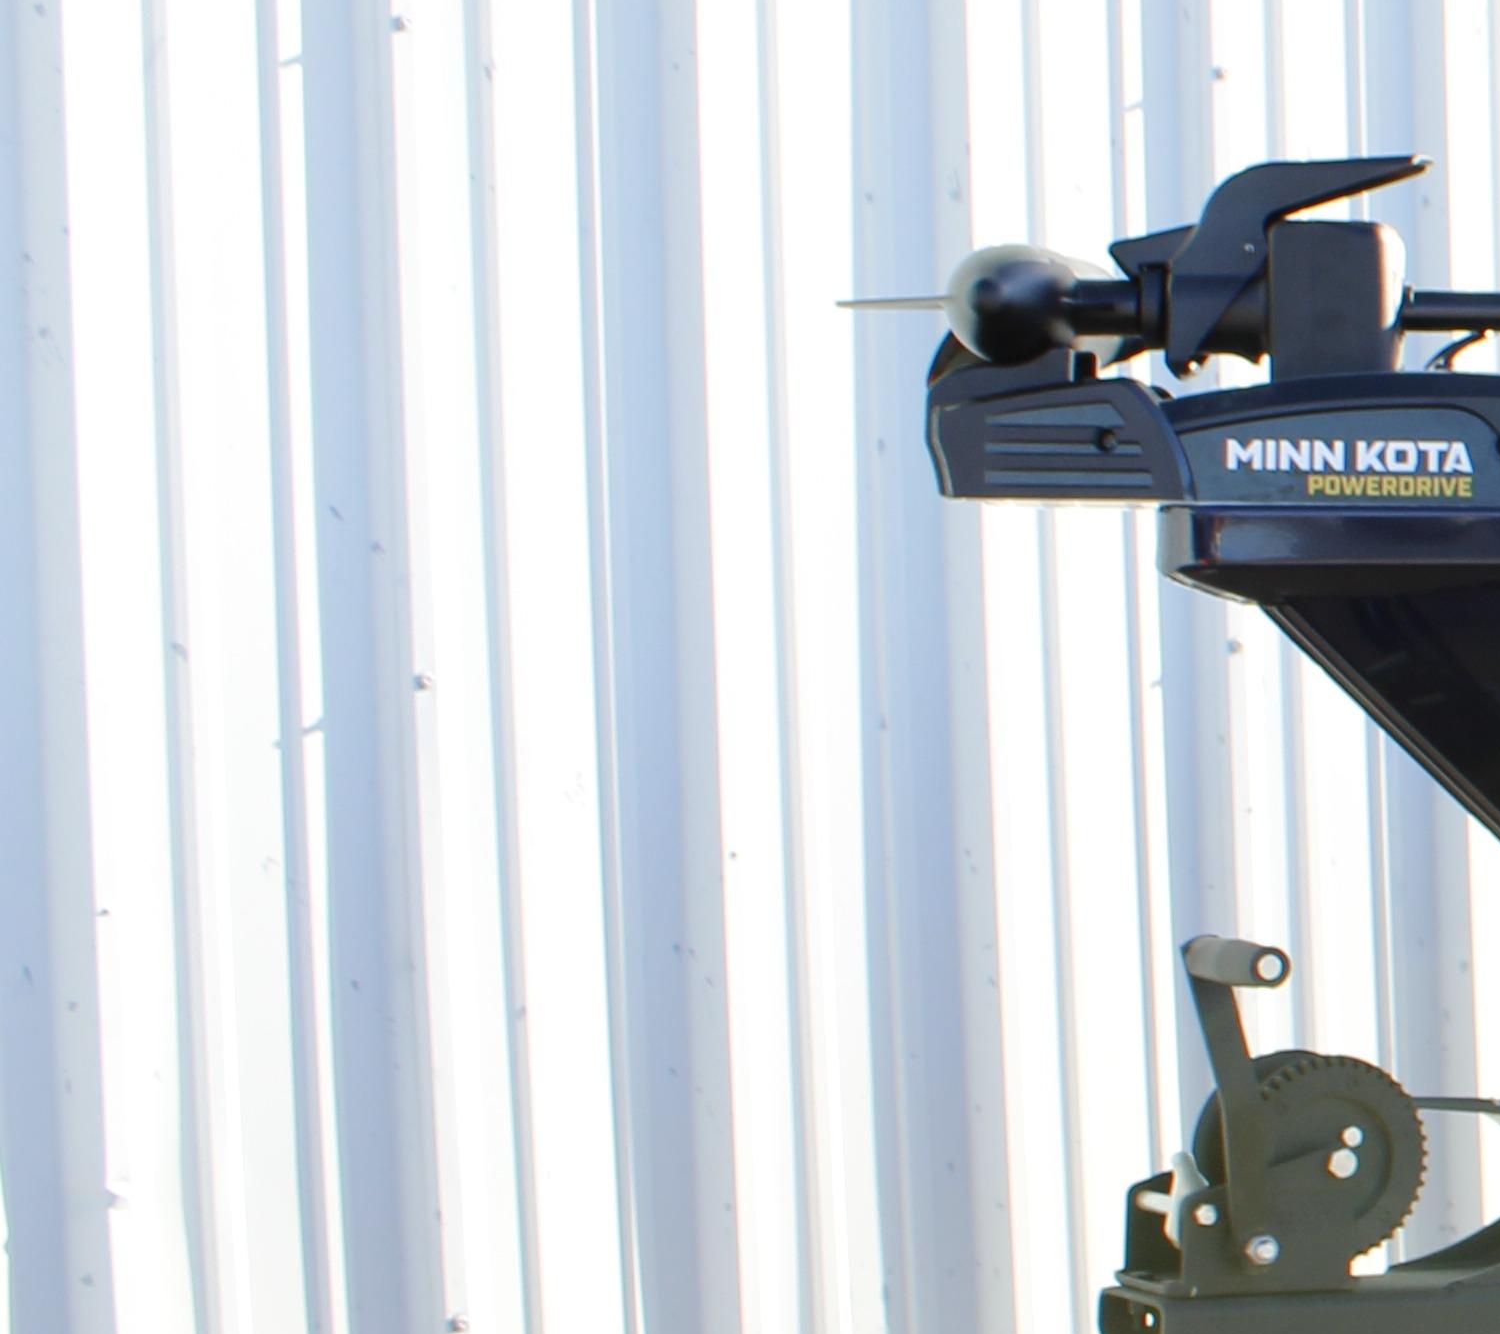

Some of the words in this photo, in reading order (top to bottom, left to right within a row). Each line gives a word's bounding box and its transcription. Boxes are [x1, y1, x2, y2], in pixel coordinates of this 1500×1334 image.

[1225, 438, 1346, 472] MINN
[1355, 440, 1474, 474] KOTA
[1307, 475, 1474, 498] POWERDRIVE
